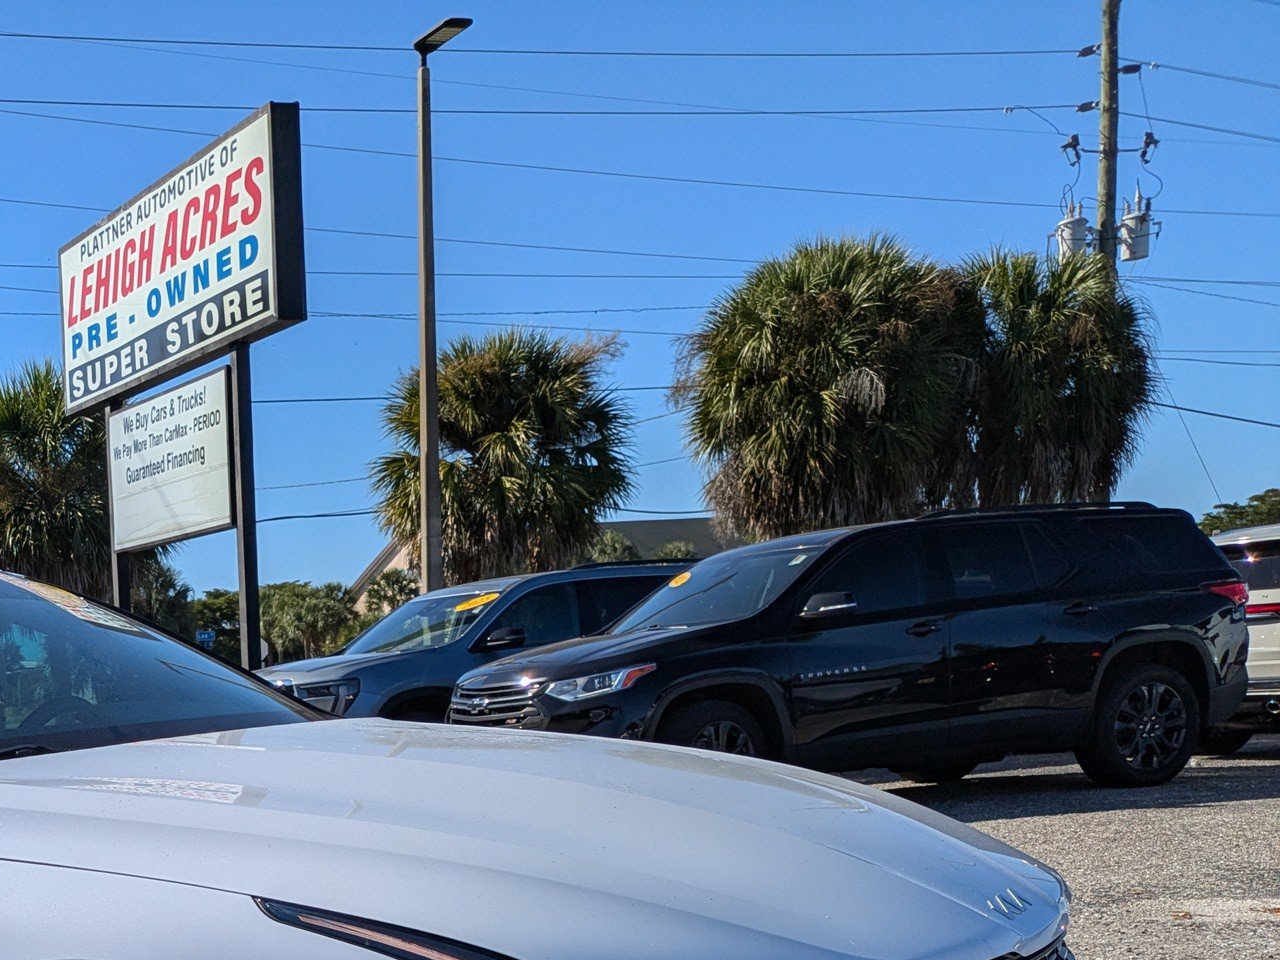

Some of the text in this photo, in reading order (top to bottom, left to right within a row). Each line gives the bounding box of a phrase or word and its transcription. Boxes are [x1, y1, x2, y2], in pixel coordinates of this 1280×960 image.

[67, 156, 264, 329] LEHIGH ACRES
[80, 138, 238, 262] PLATTNER AUTOMOTIVE OF
[72, 276, 264, 399] SUPER STORE
[113, 447, 122, 461] We
[122, 442, 133, 460] Pay
[133, 437, 147, 454] More
[148, 431, 164, 448] Than
[164, 422, 188, 443] CarMax
[193, 409, 221, 434] PERIOD
[122, 385, 207, 435] We Buy Cars & Trucks!
[125, 444, 206, 485] Guaranteed Financing
